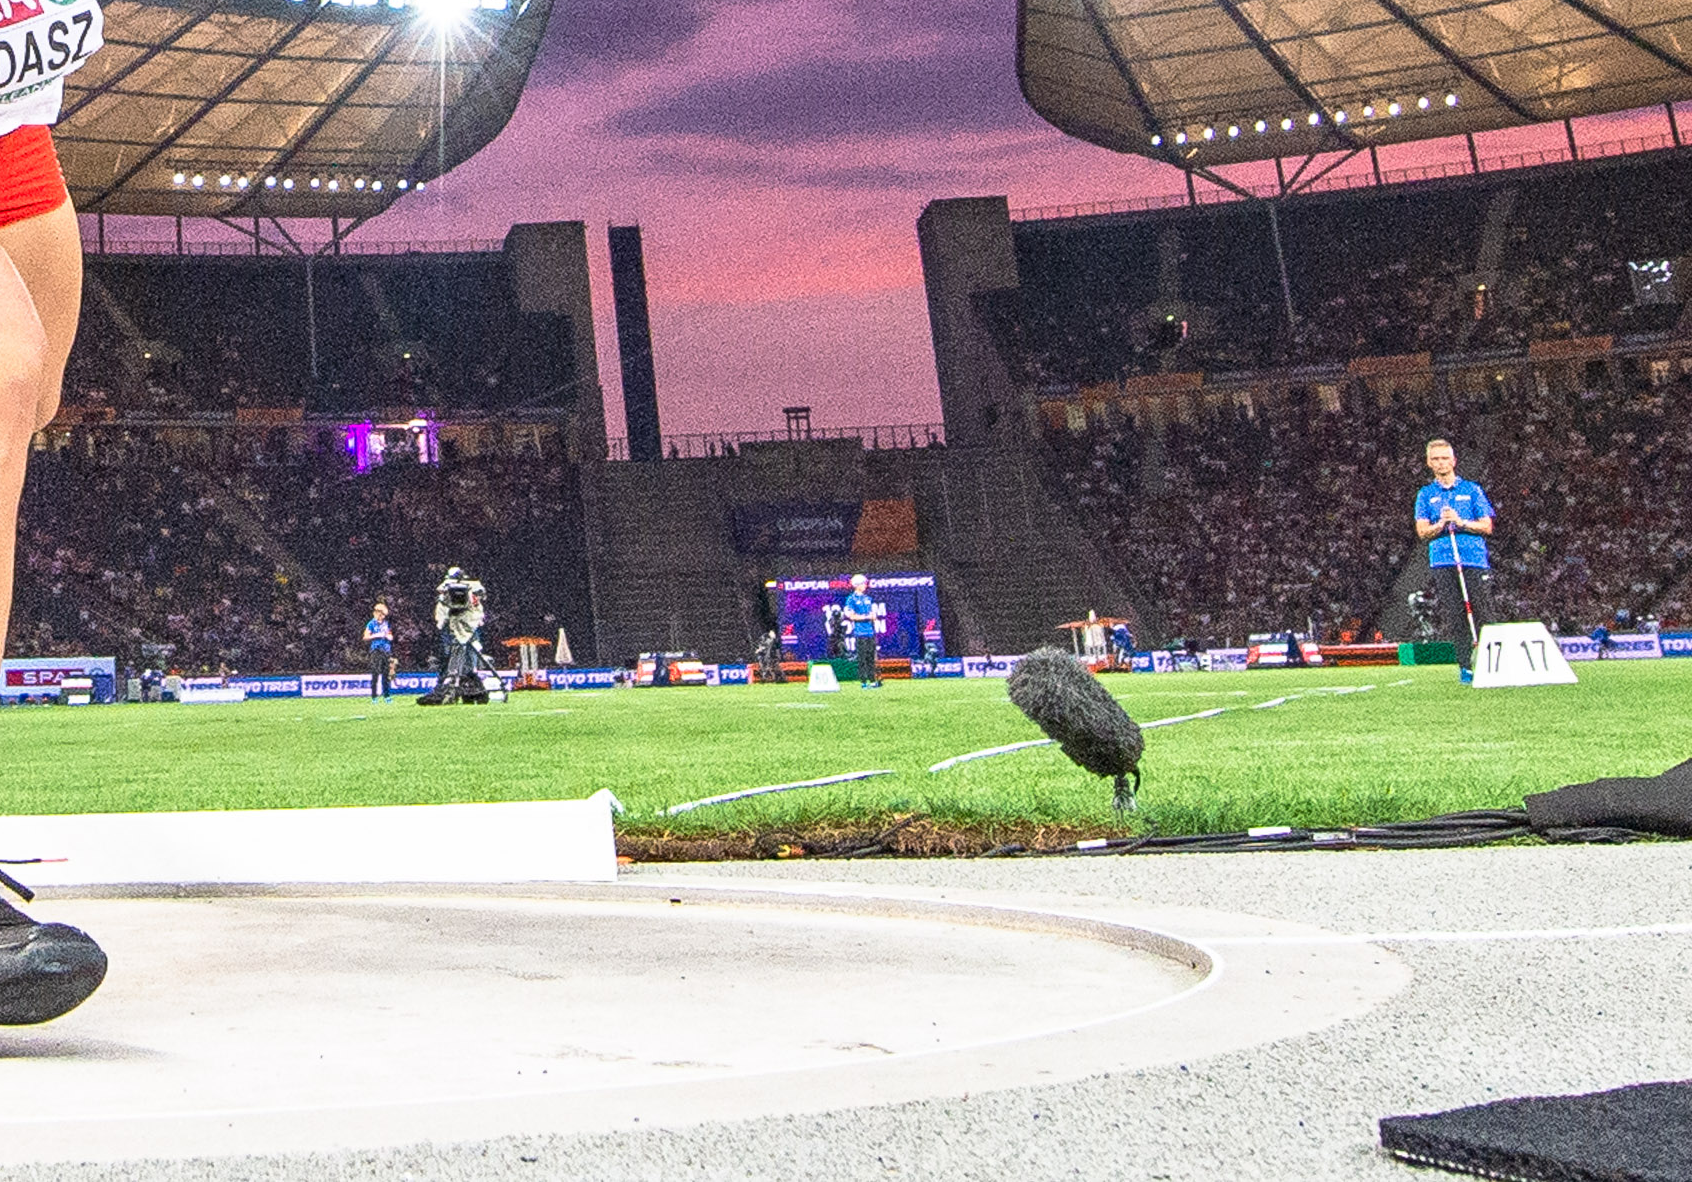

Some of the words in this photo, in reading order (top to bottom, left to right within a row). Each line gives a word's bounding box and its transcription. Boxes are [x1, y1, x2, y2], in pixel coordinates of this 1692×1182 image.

[1486, 640, 1503, 673] 17
[1520, 639, 1549, 672] 17
[549, 673, 586, 685] TOYO
[720, 669, 748, 680] TOY
[263, 680, 299, 691] TIRES
[304, 680, 339, 691] TOYO
[340, 679, 372, 690] TIRE
